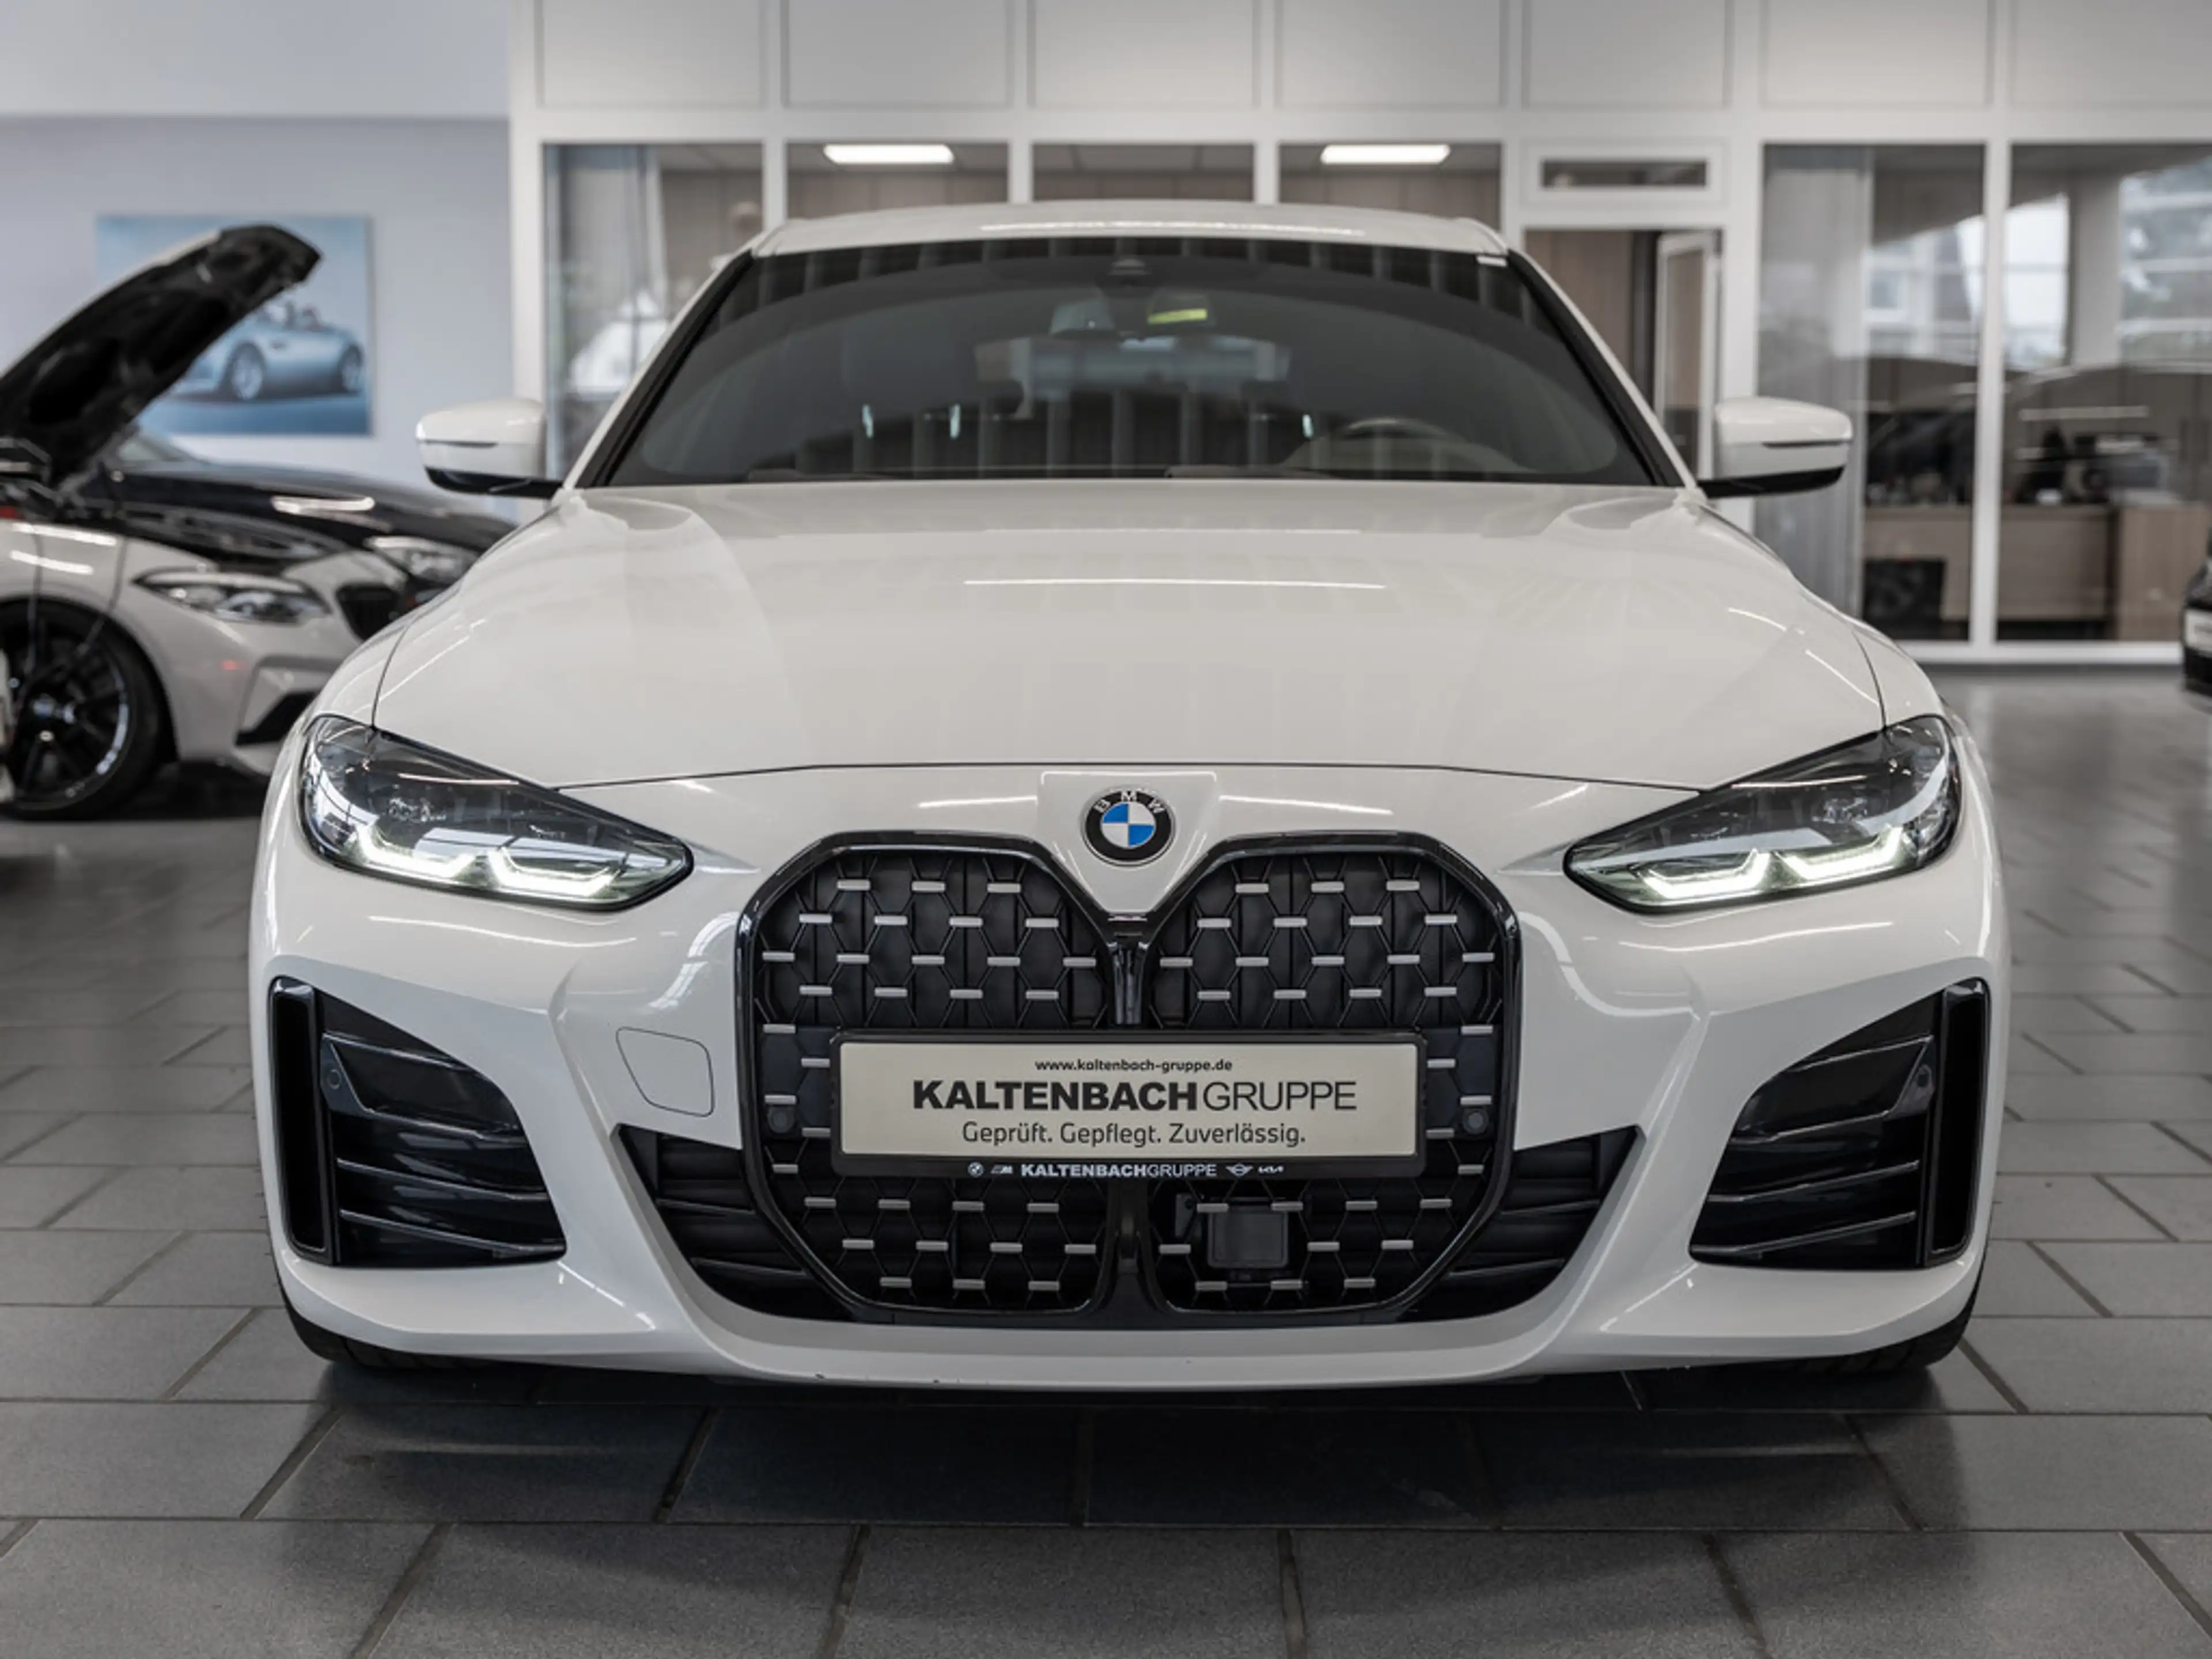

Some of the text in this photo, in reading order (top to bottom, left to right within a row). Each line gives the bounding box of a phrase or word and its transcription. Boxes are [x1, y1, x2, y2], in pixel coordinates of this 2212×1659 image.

[1093, 791, 1165, 813] BMW
[1034, 1058, 1233, 1074] www.kaltenbach-gruppe.de
[962, 1120, 1306, 1147] Geprüft. Gepflegt. Zuverlässig.
